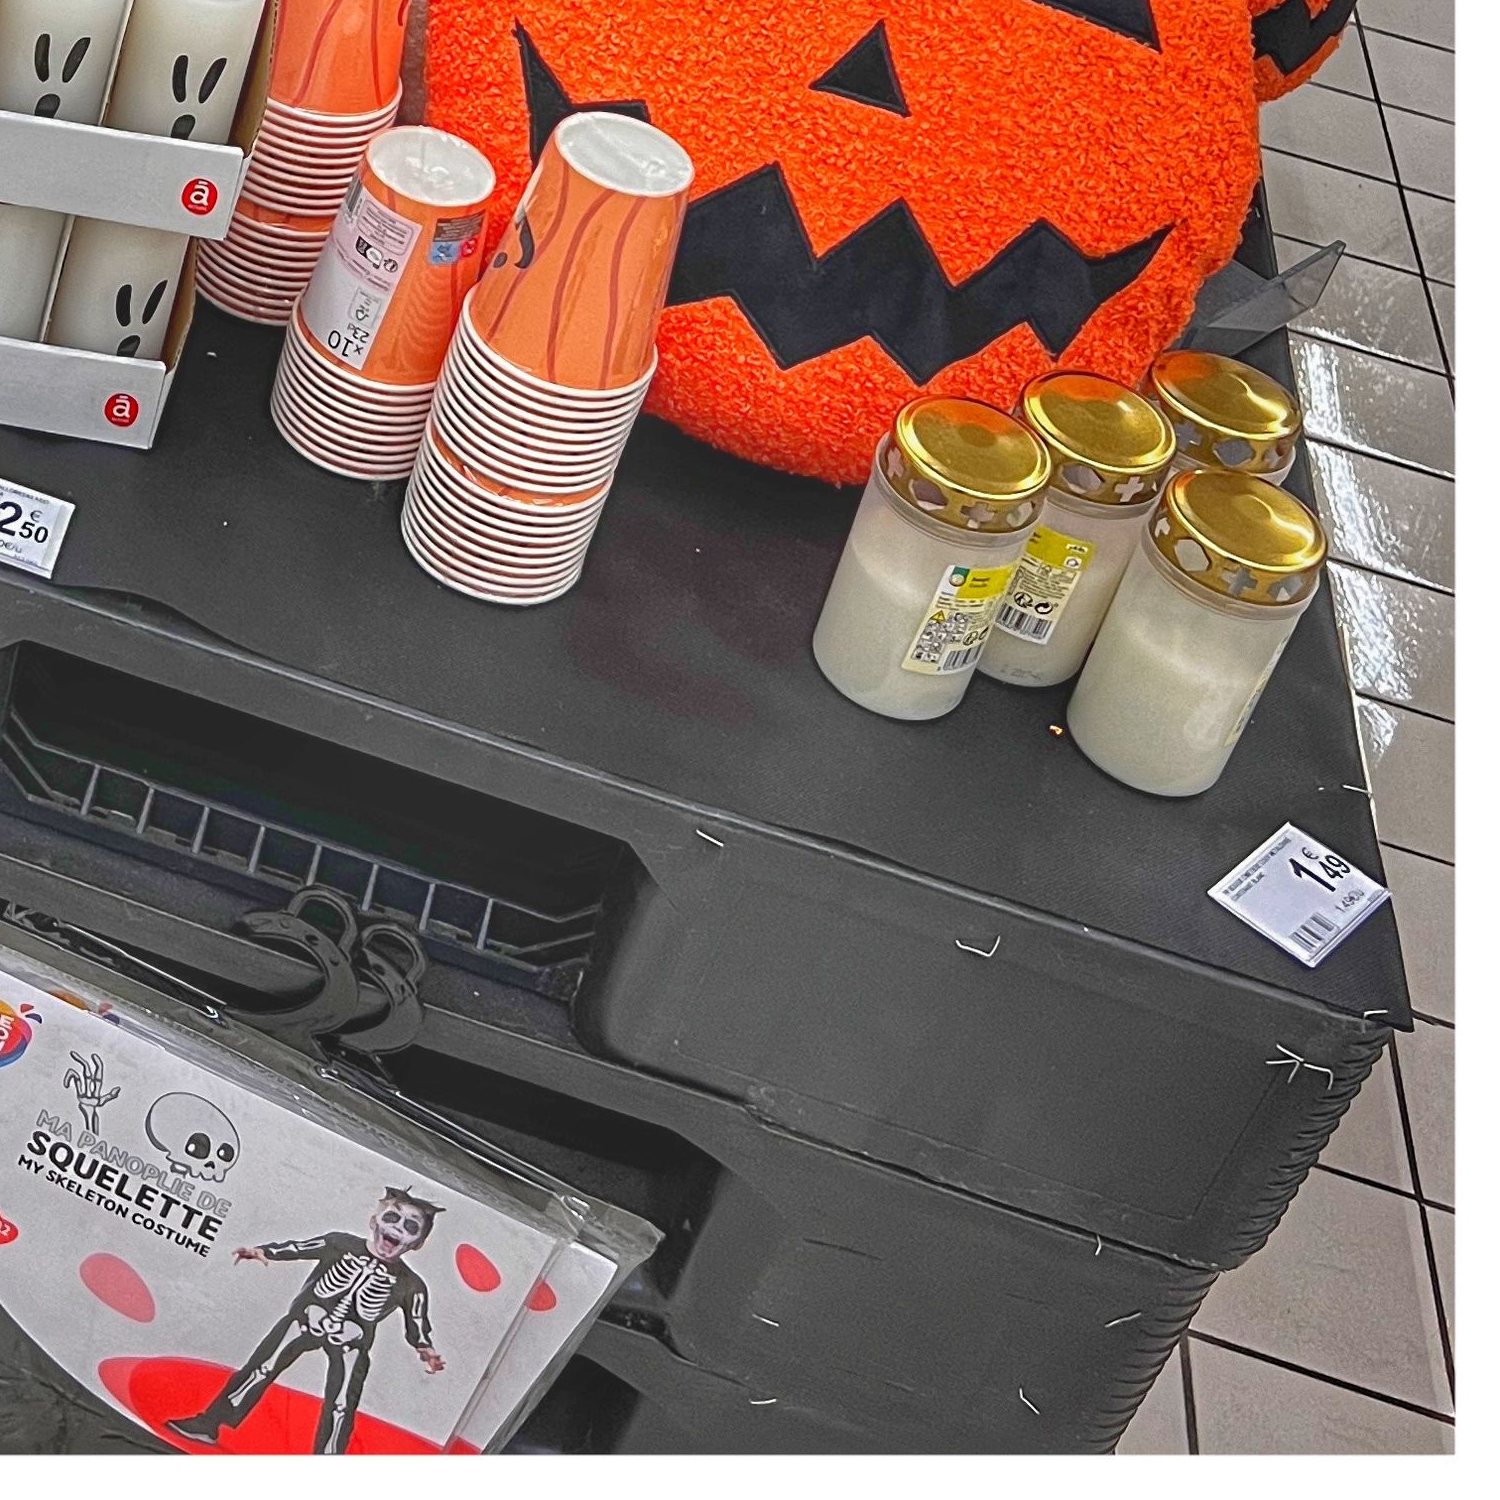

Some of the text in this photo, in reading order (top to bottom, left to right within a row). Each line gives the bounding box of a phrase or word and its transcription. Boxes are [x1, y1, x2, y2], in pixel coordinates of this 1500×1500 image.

[18, 1154, 210, 1258] MY SKELETON COSTUME
[27, 1131, 223, 1242] SQUELETTE
[36, 1110, 232, 1218] MA PANOPLIE DE
